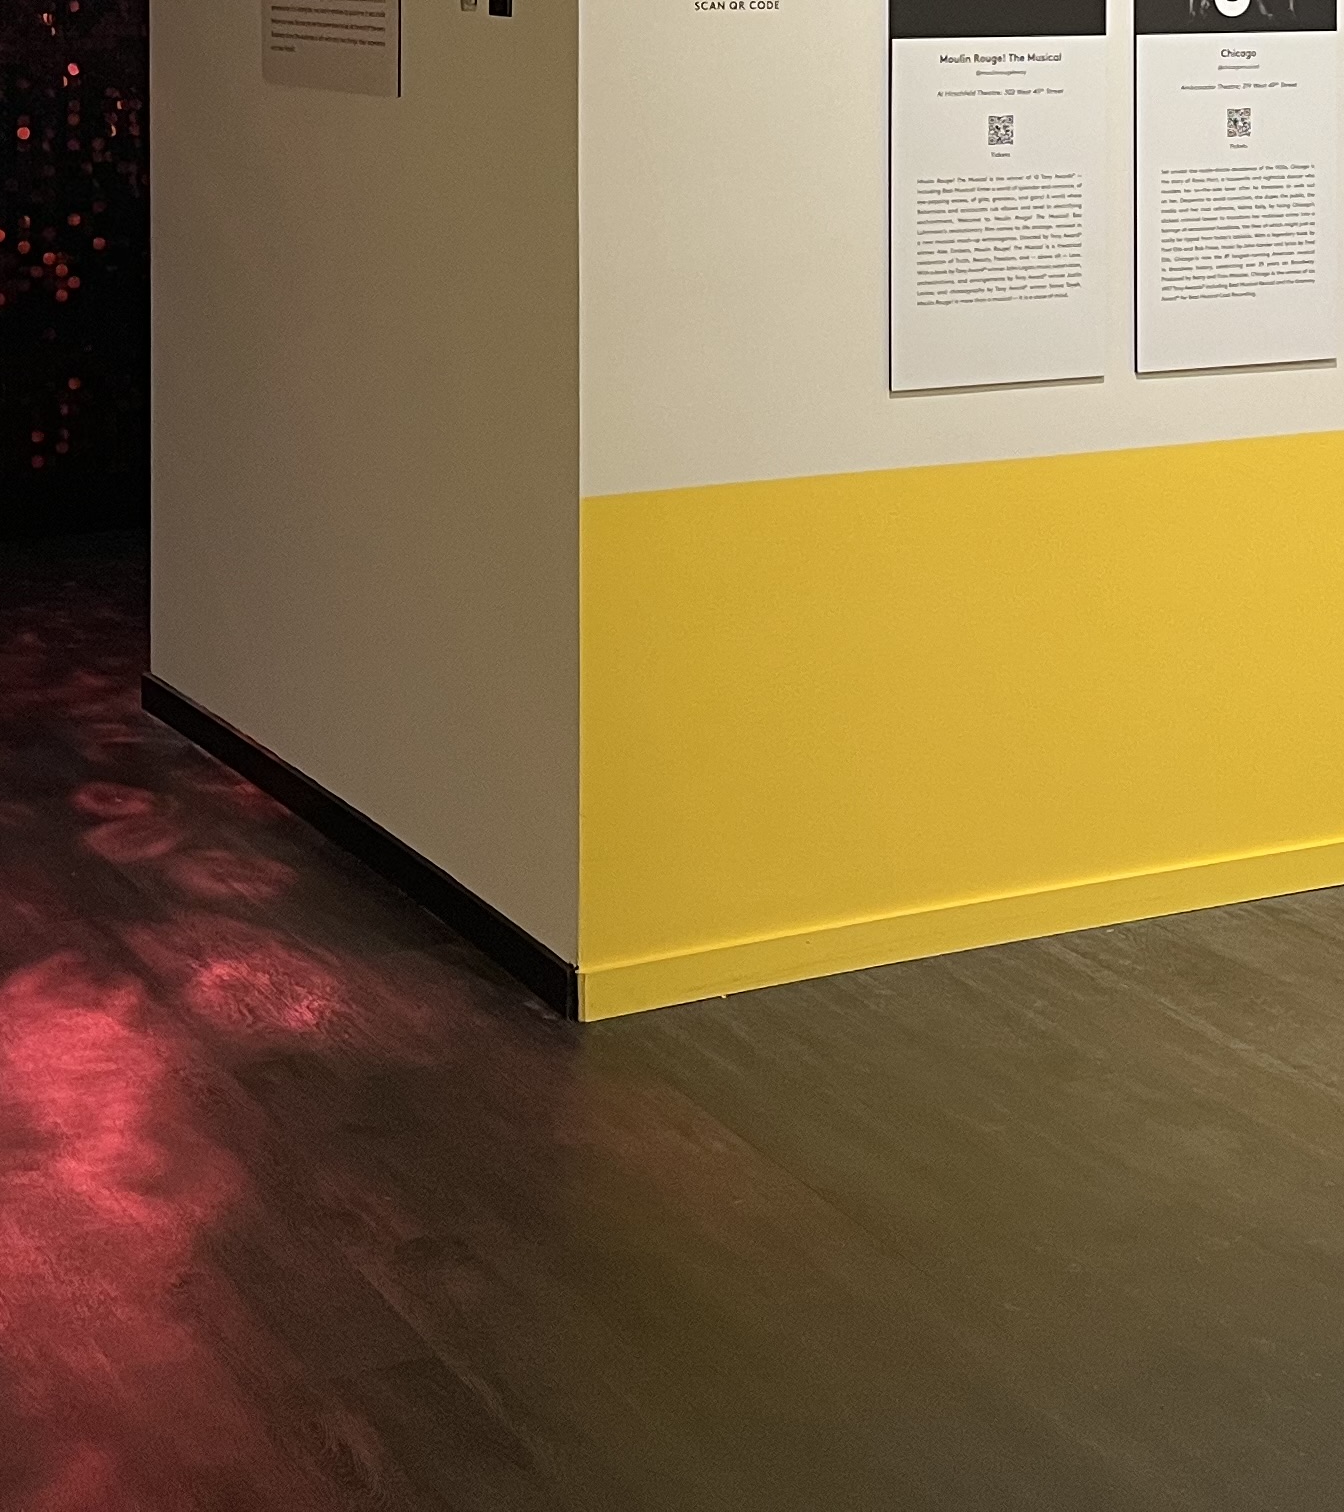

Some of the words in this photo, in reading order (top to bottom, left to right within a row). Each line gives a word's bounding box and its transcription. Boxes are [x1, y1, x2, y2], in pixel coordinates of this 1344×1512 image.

[694, 1, 725, 11] SCAN
[729, 1, 746, 10] QR
[749, 0, 779, 10] CODE
[940, 54, 971, 64] Moulin
[974, 53, 1006, 65] Rouge!
[1009, 53, 1025, 62] The
[1027, 52, 1062, 62] Musical
[1220, 48, 1257, 59] Chicago
